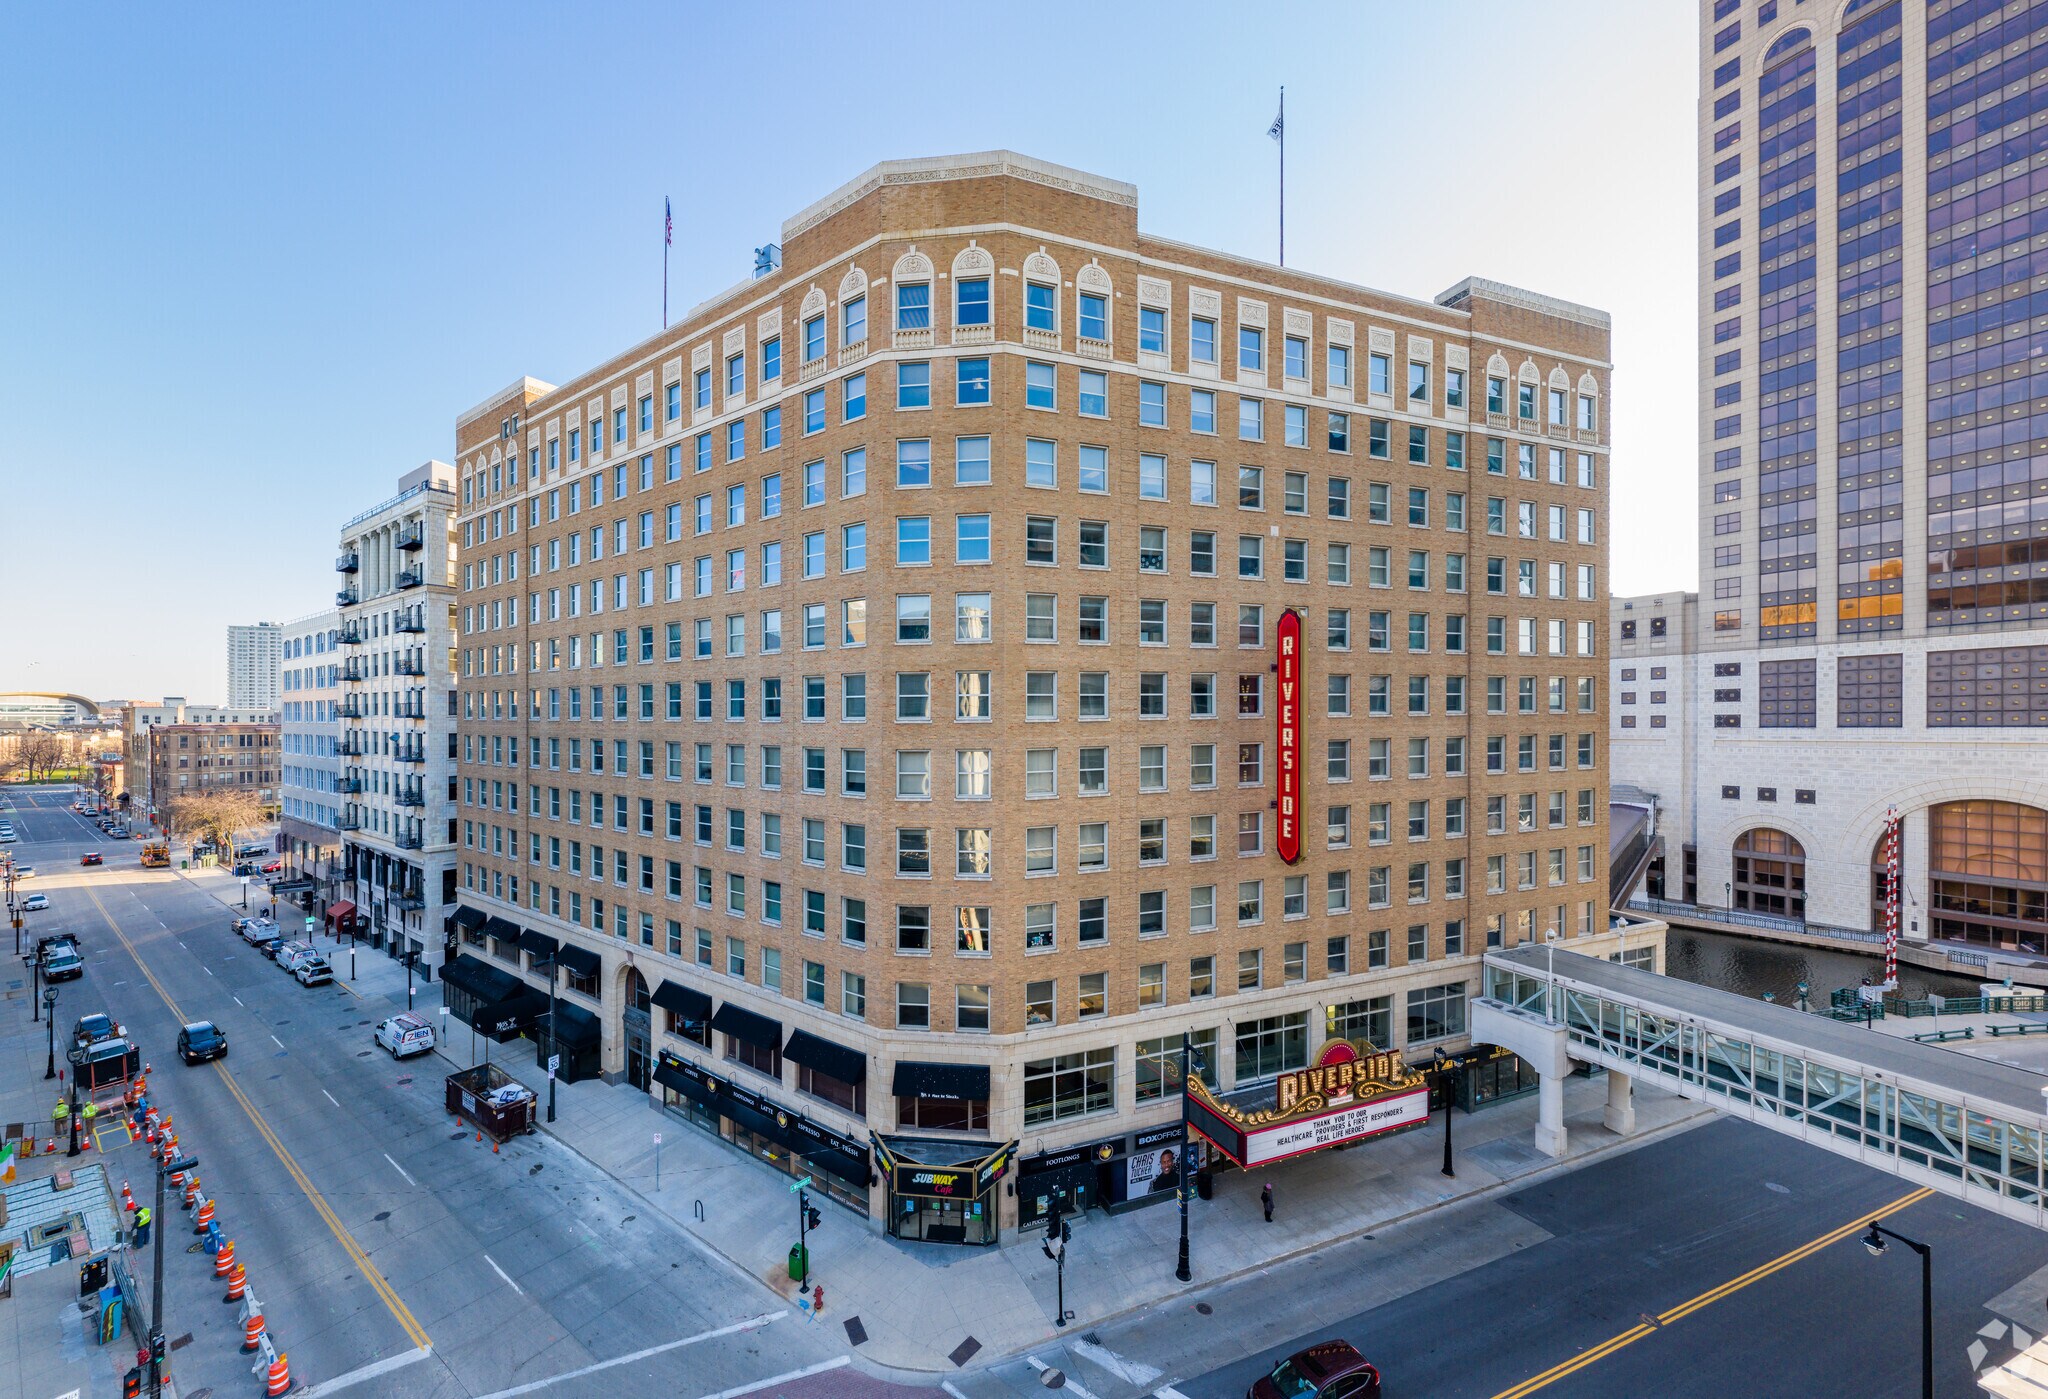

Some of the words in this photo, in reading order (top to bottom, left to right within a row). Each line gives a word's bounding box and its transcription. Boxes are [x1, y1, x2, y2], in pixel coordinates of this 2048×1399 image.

[1282, 635, 1294, 839] RIVERSIDE
[1278, 1050, 1403, 1110] RIVERSIDE
[760, 1104, 774, 1115] LATTE
[1277, 1131, 1312, 1146] HEALTHCARE
[1315, 1122, 1346, 1137] PROVIDERS
[1353, 1116, 1368, 1126] FIRST
[1370, 1107, 1403, 1121] RESPONDERS
[1313, 1120, 1330, 1129] THANK
[1334, 1115, 1346, 1124] YOU
[1347, 1112, 1355, 1120] TO
[1356, 1109, 1367, 1118] OUR
[797, 1122, 820, 1138] ESPRESSO
[1316, 1135, 1330, 1143] REAL
[1332, 1130, 1344, 1139] LIFE
[1345, 1125, 1365, 1136] HEROES
[830, 1139, 839, 1148] EAT
[842, 1145, 859, 1157] FRESH
[980, 1153, 1008, 1183] SUBWAY
[1046, 1153, 1080, 1166] FOOTLONGS
[1131, 1153, 1155, 1169] CHRIS
[911, 1173, 958, 1185] SUBWAY
[934, 1184, 953, 1195] Cafe
